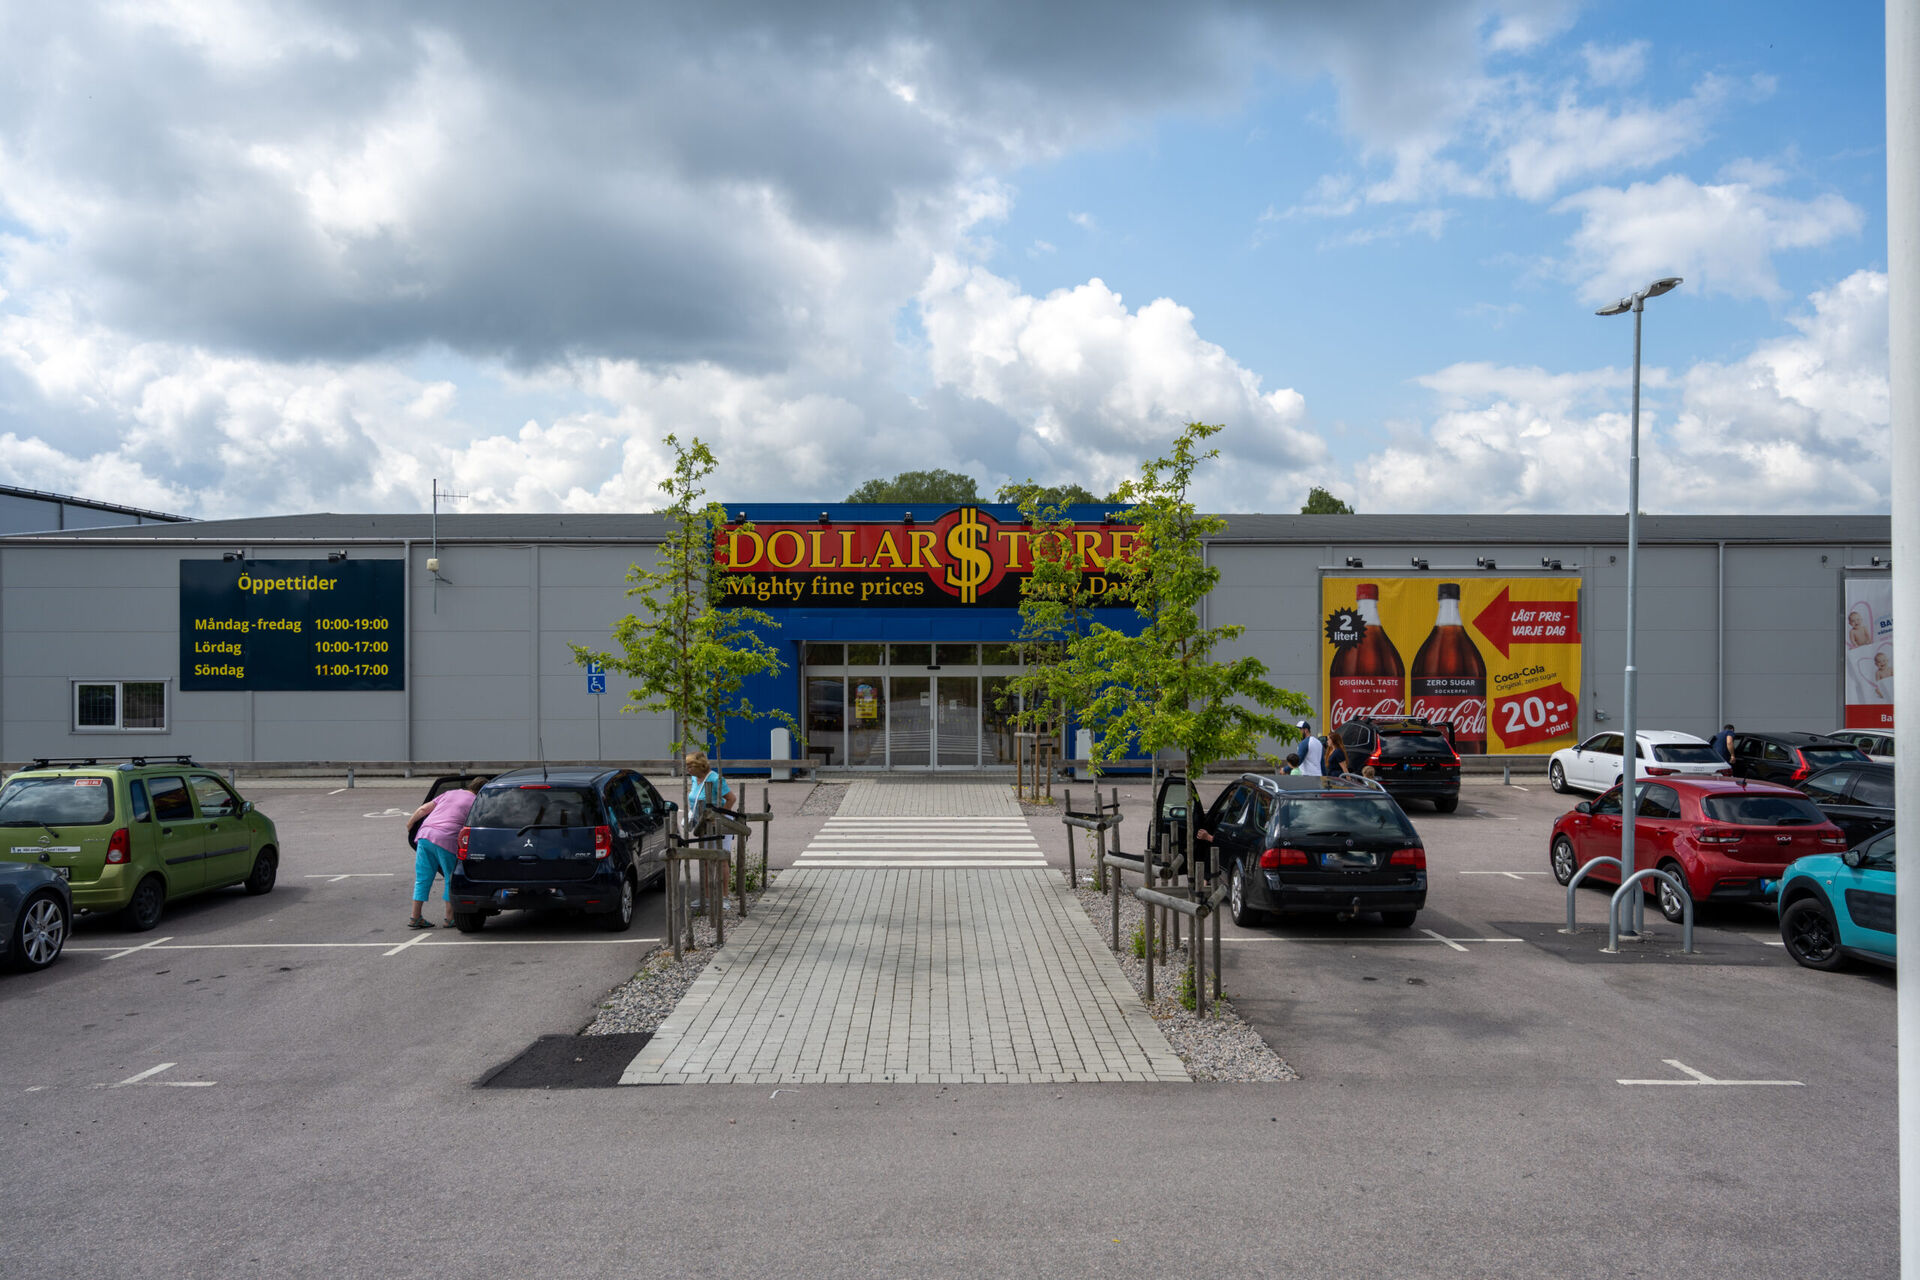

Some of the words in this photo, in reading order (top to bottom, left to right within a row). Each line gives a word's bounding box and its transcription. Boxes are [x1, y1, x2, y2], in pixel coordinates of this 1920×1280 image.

[238, 573, 337, 594] Öppettider
[727, 576, 806, 601] Mighty
[811, 576, 855, 596] fine
[861, 576, 924, 601] prices
[1339, 615, 1352, 631] 2
[1511, 610, 1536, 622] LÅGT
[1538, 611, 1562, 622] PRIS
[315, 618, 389, 631] 10:00-19:00
[1512, 625, 1543, 637] VARJE
[1545, 625, 1566, 636] DAG
[1334, 631, 1359, 641] liter!
[195, 641, 242, 655] Lördag
[315, 641, 389, 653] 10:00-17:00
[194, 664, 245, 678] Söndag
[315, 664, 389, 676] 11:00-17:00
[1494, 665, 1545, 684] Coca-Cola
[1426, 679, 1448, 687] ZERO
[1449, 679, 1476, 687] SUGAR
[1501, 696, 1568, 734] 20:-
